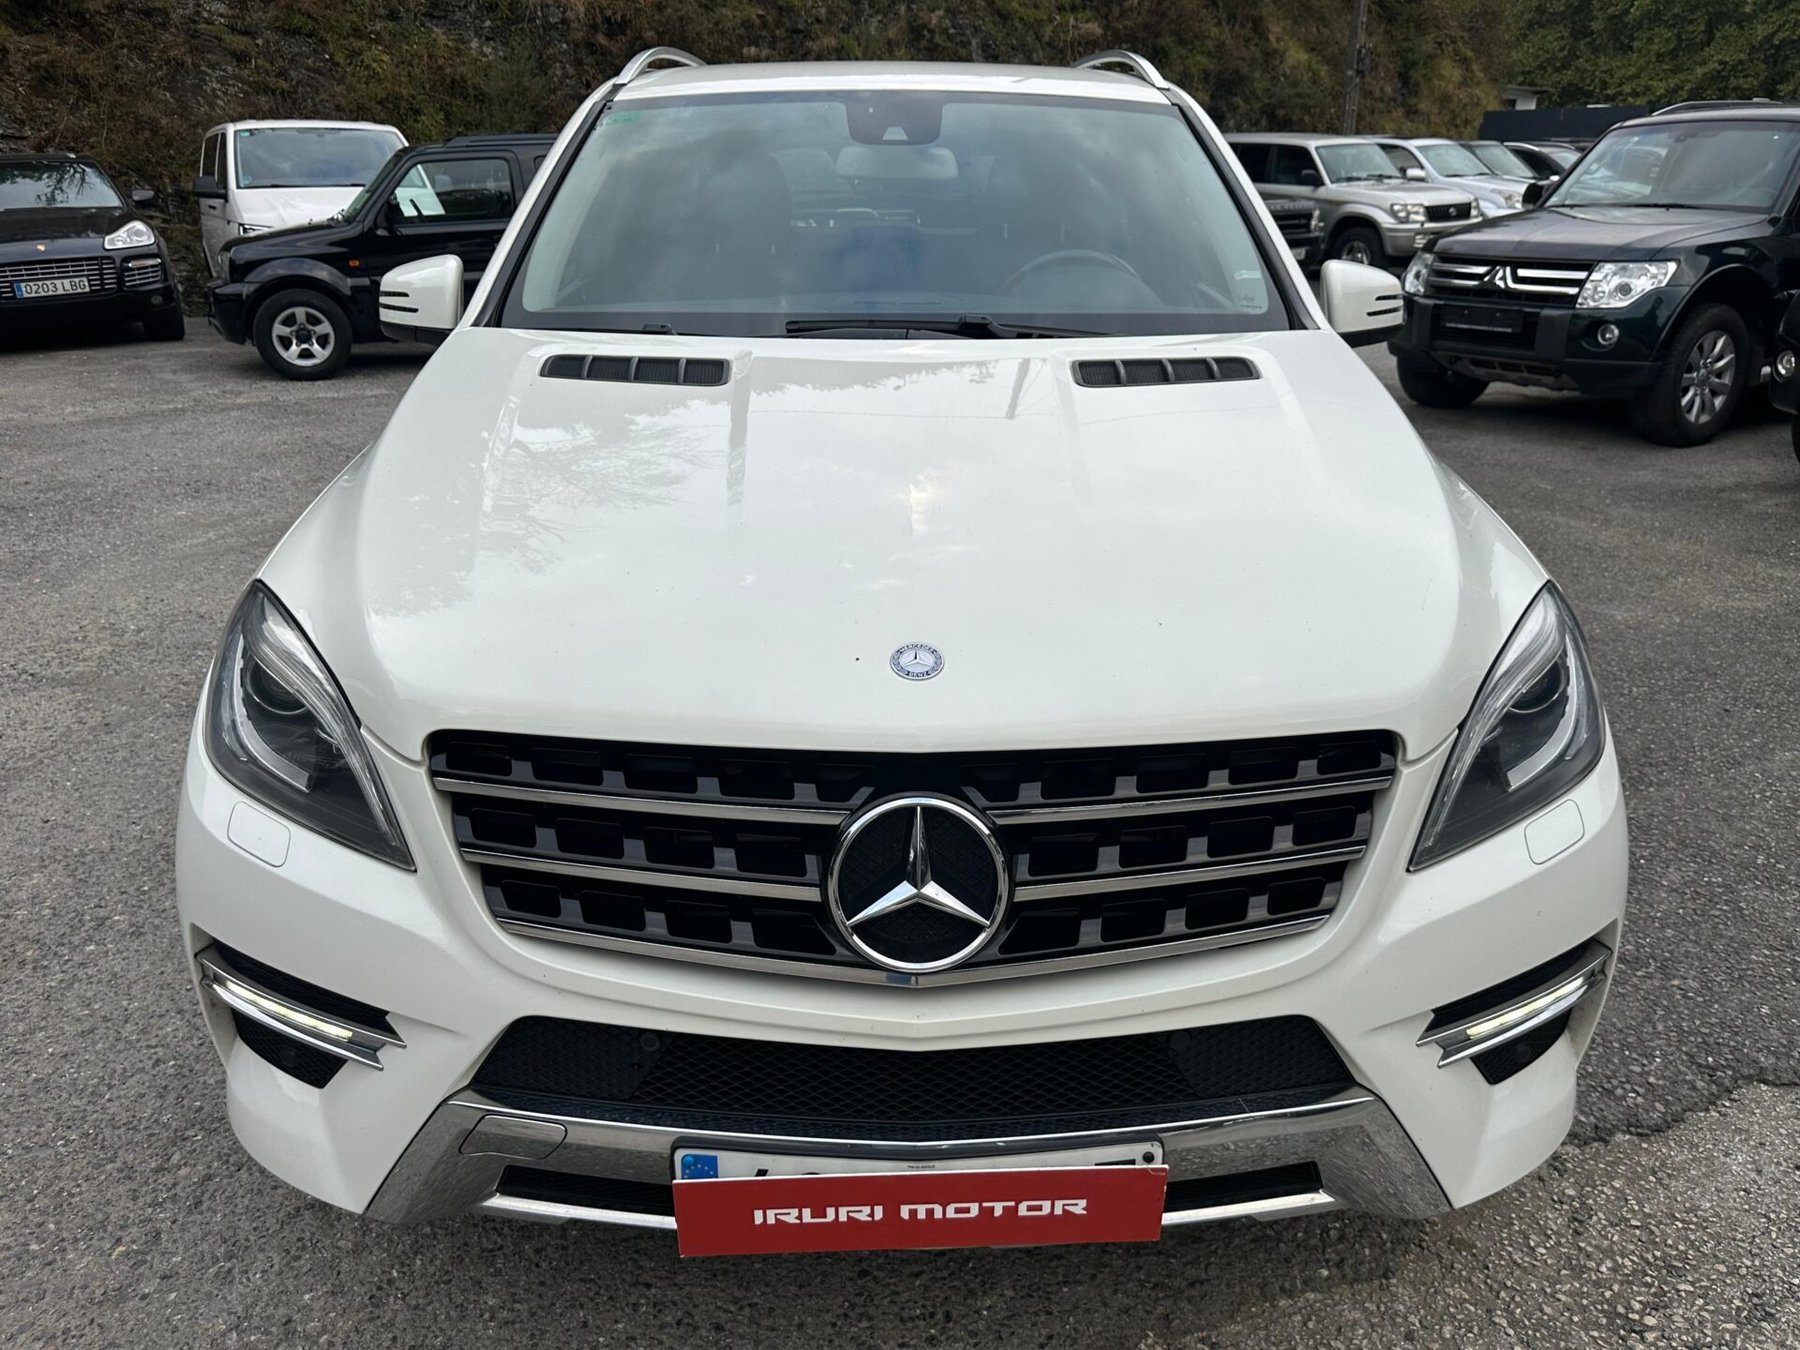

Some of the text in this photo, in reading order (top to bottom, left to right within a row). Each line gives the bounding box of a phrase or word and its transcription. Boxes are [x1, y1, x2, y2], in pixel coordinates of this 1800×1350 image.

[24, 279, 87, 295] 0203 LBG
[753, 1199, 1088, 1225] IRURI MOTOR
